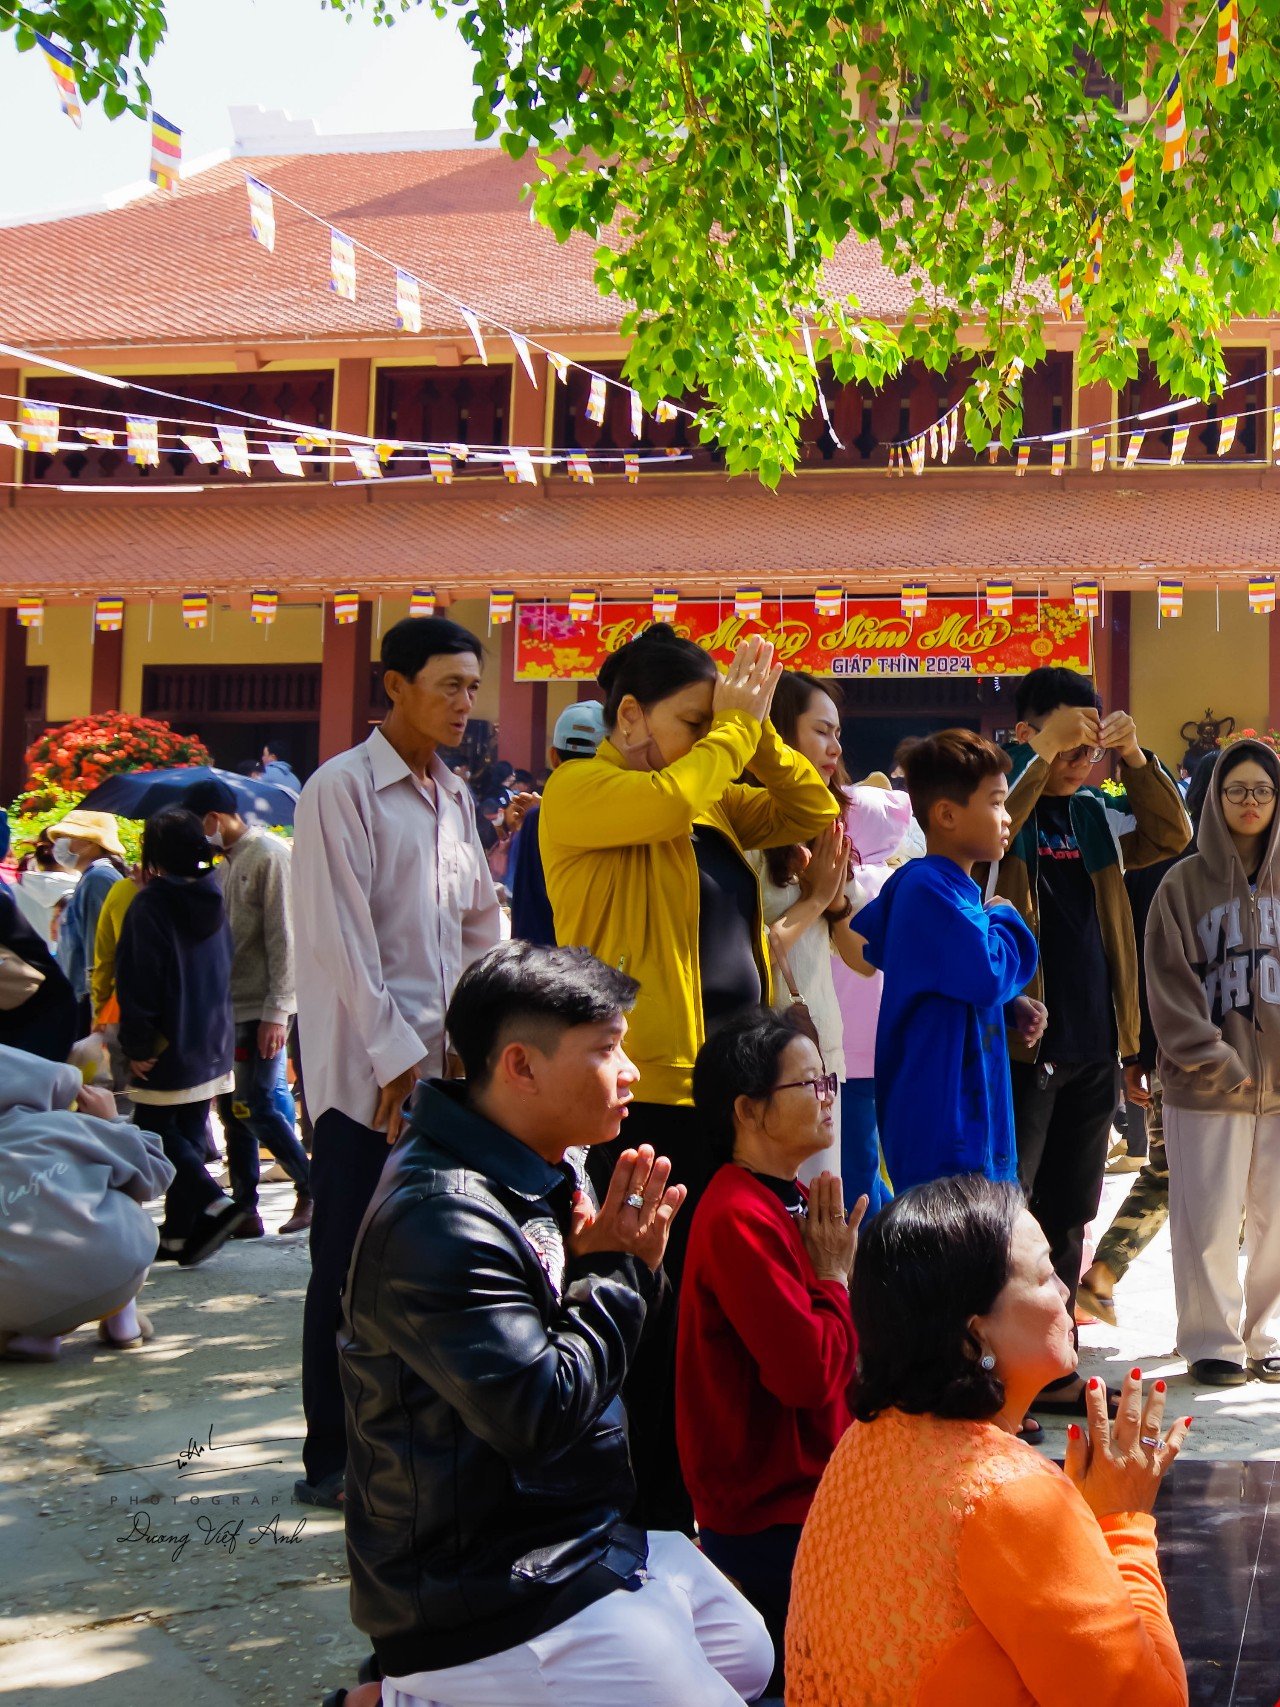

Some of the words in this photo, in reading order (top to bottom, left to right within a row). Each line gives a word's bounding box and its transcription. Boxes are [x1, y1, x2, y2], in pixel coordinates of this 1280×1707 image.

[818, 613, 912, 651] Năm
[917, 612, 1011, 653] Mới
[832, 654, 873, 673] GIÁP
[878, 654, 919, 673] THÌN
[926, 656, 972, 673] 2024
